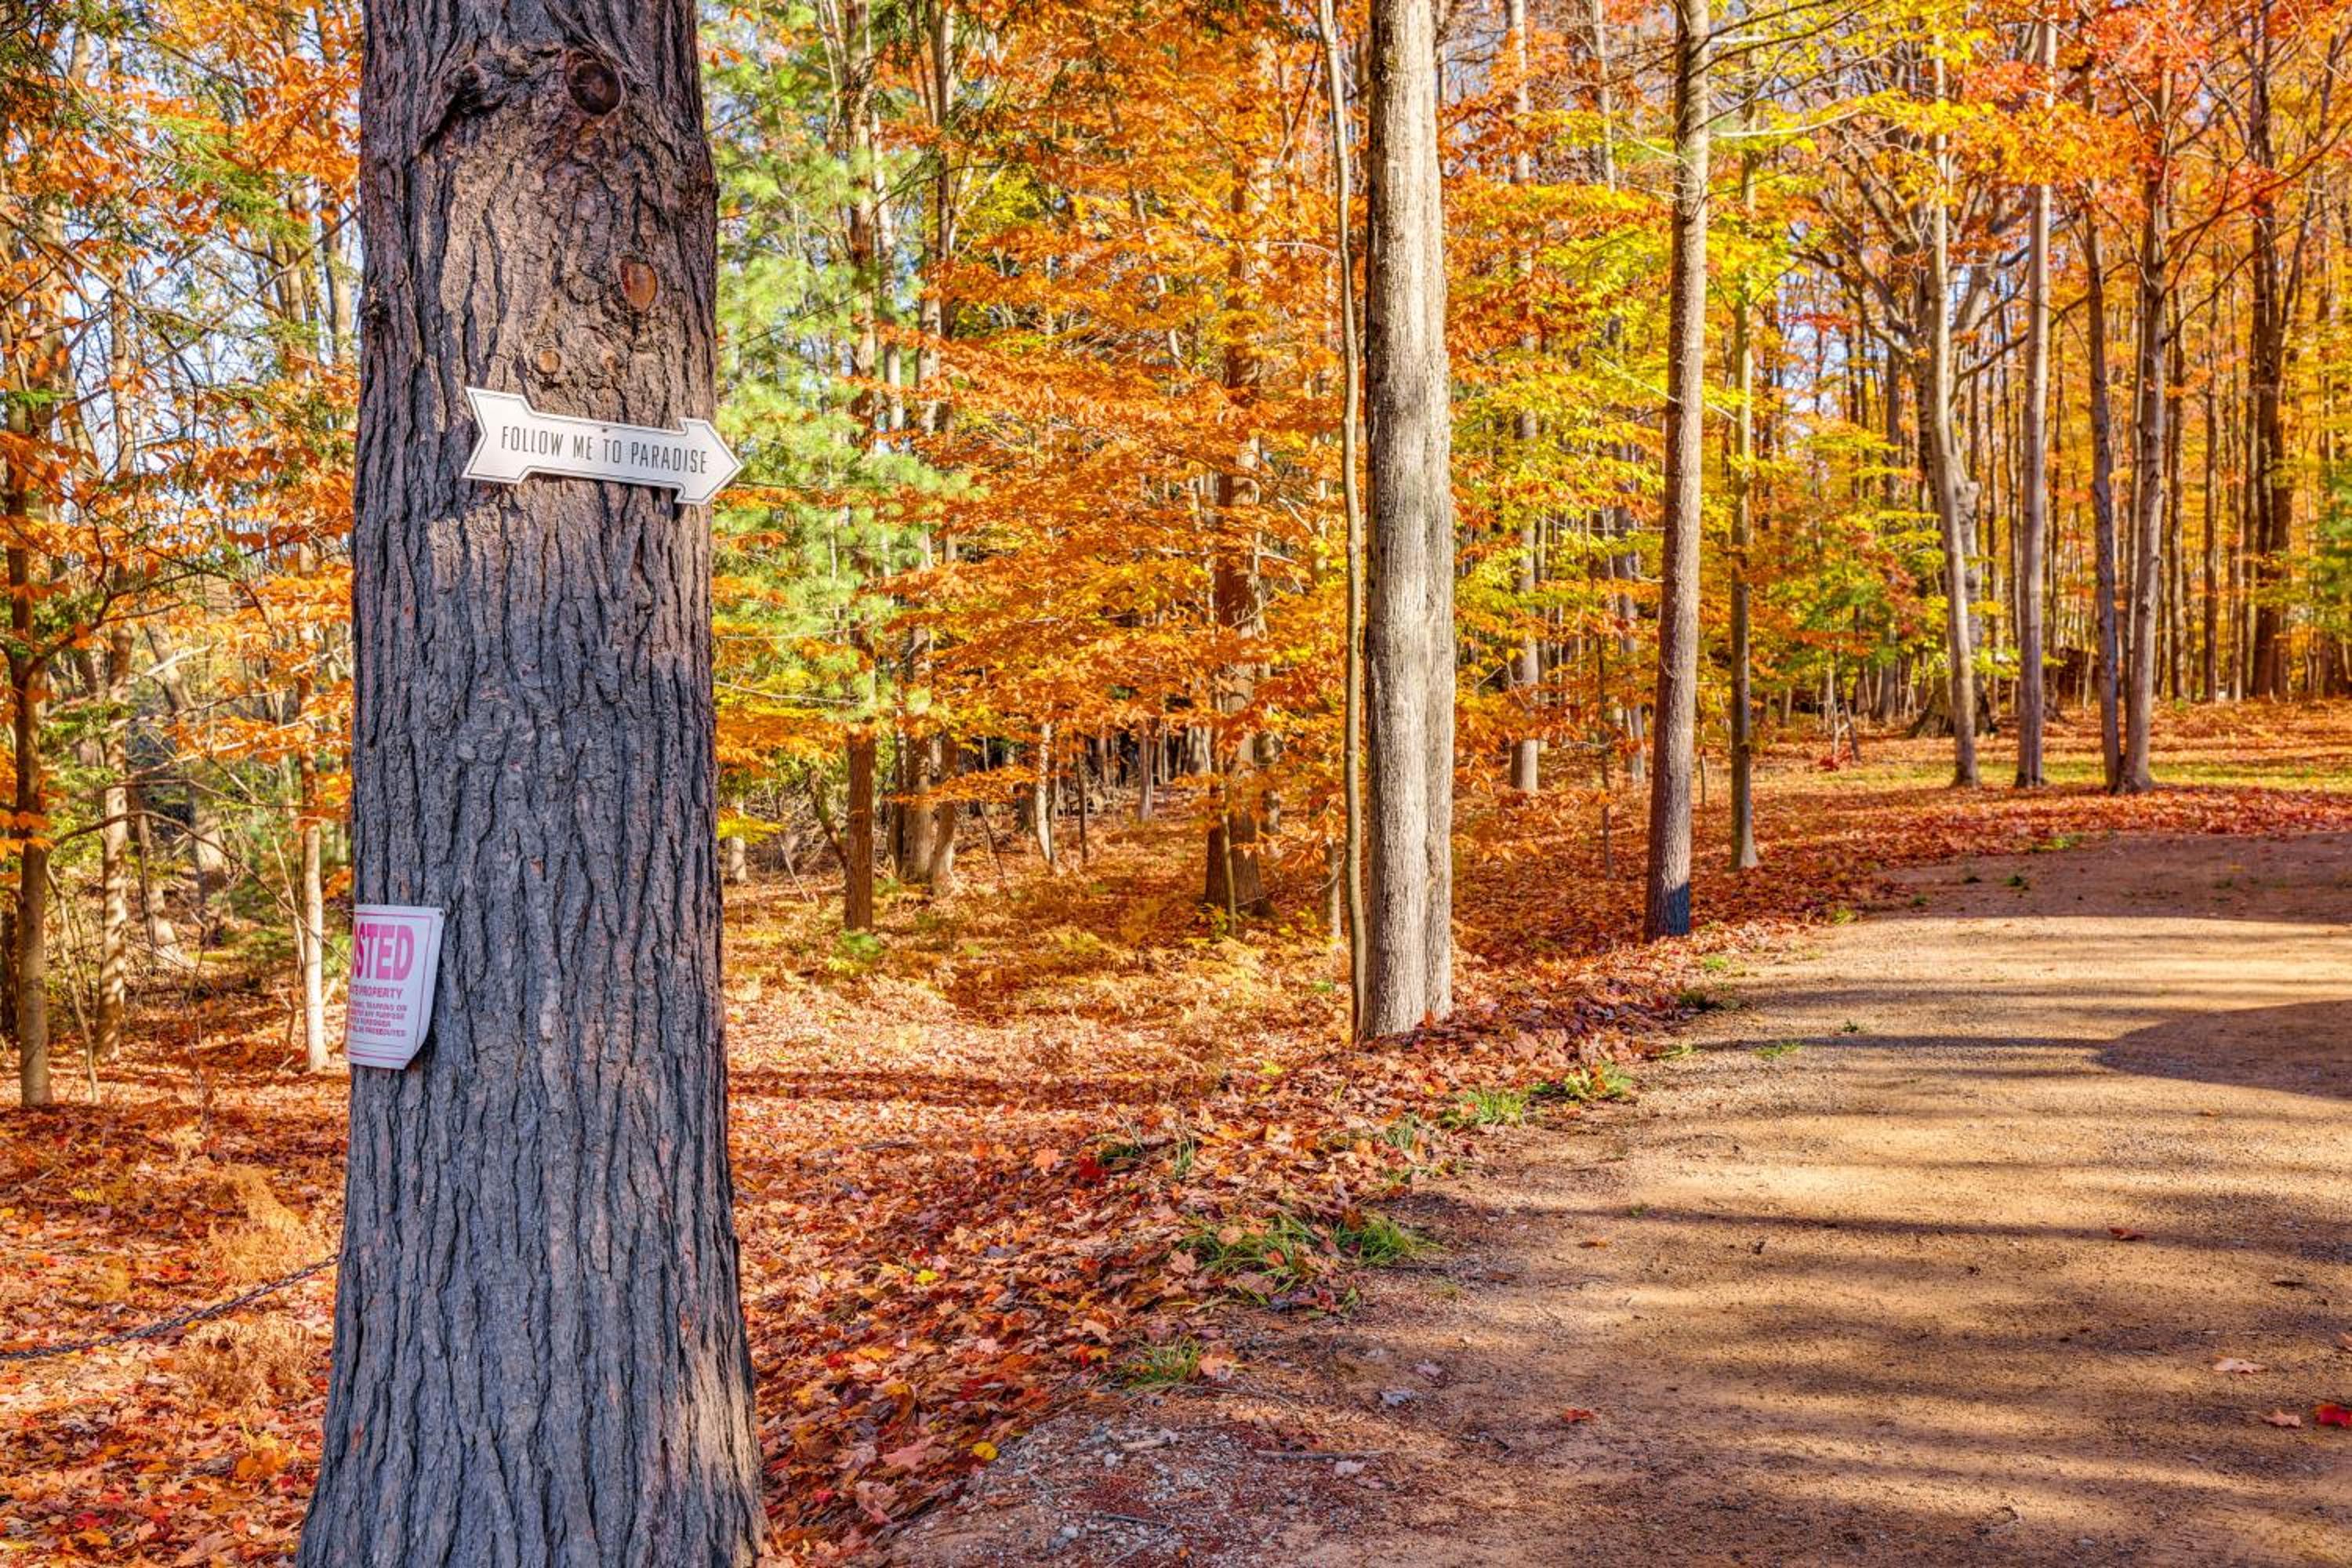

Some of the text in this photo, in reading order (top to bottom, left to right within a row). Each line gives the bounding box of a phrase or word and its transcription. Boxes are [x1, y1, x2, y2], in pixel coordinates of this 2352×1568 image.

[502, 426, 707, 474] FOLLOW ME TO PARADISE
[360, 985, 404, 999] PROPERTY
